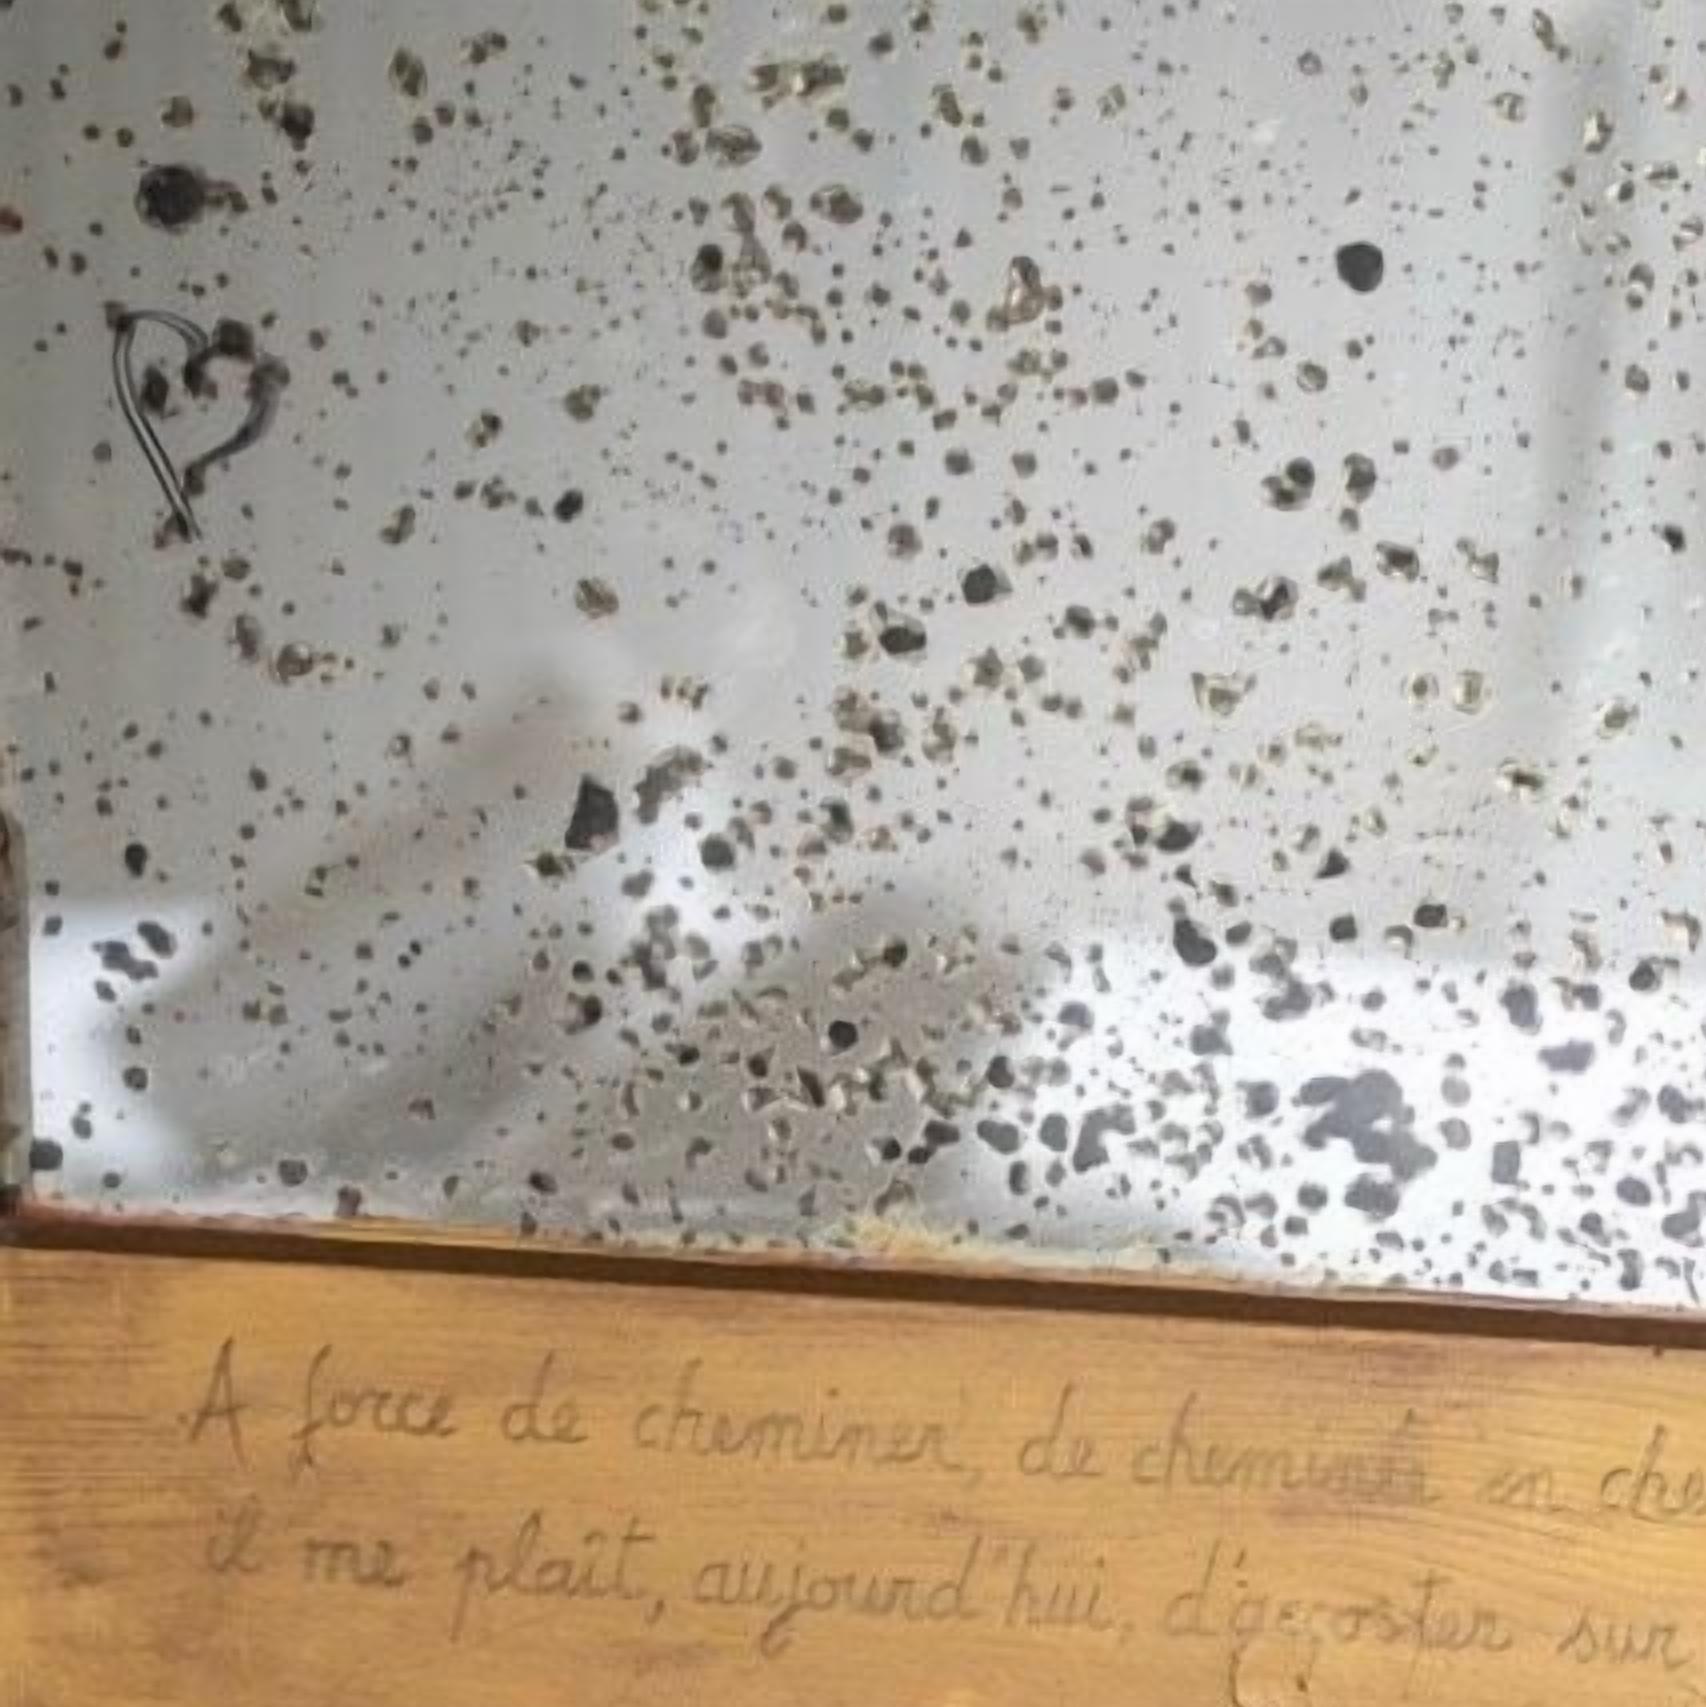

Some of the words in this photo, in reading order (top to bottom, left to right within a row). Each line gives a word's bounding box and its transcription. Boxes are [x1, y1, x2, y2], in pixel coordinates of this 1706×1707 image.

[190, 1336, 252, 1472] A
[290, 1345, 458, 1470] force
[499, 1350, 590, 1444] de
[1018, 1382, 1105, 1480] de
[1480, 1466, 1564, 1514] en
[205, 1492, 264, 1573] il
[300, 1534, 406, 1588] me
[1556, 1604, 1694, 1671] sur
